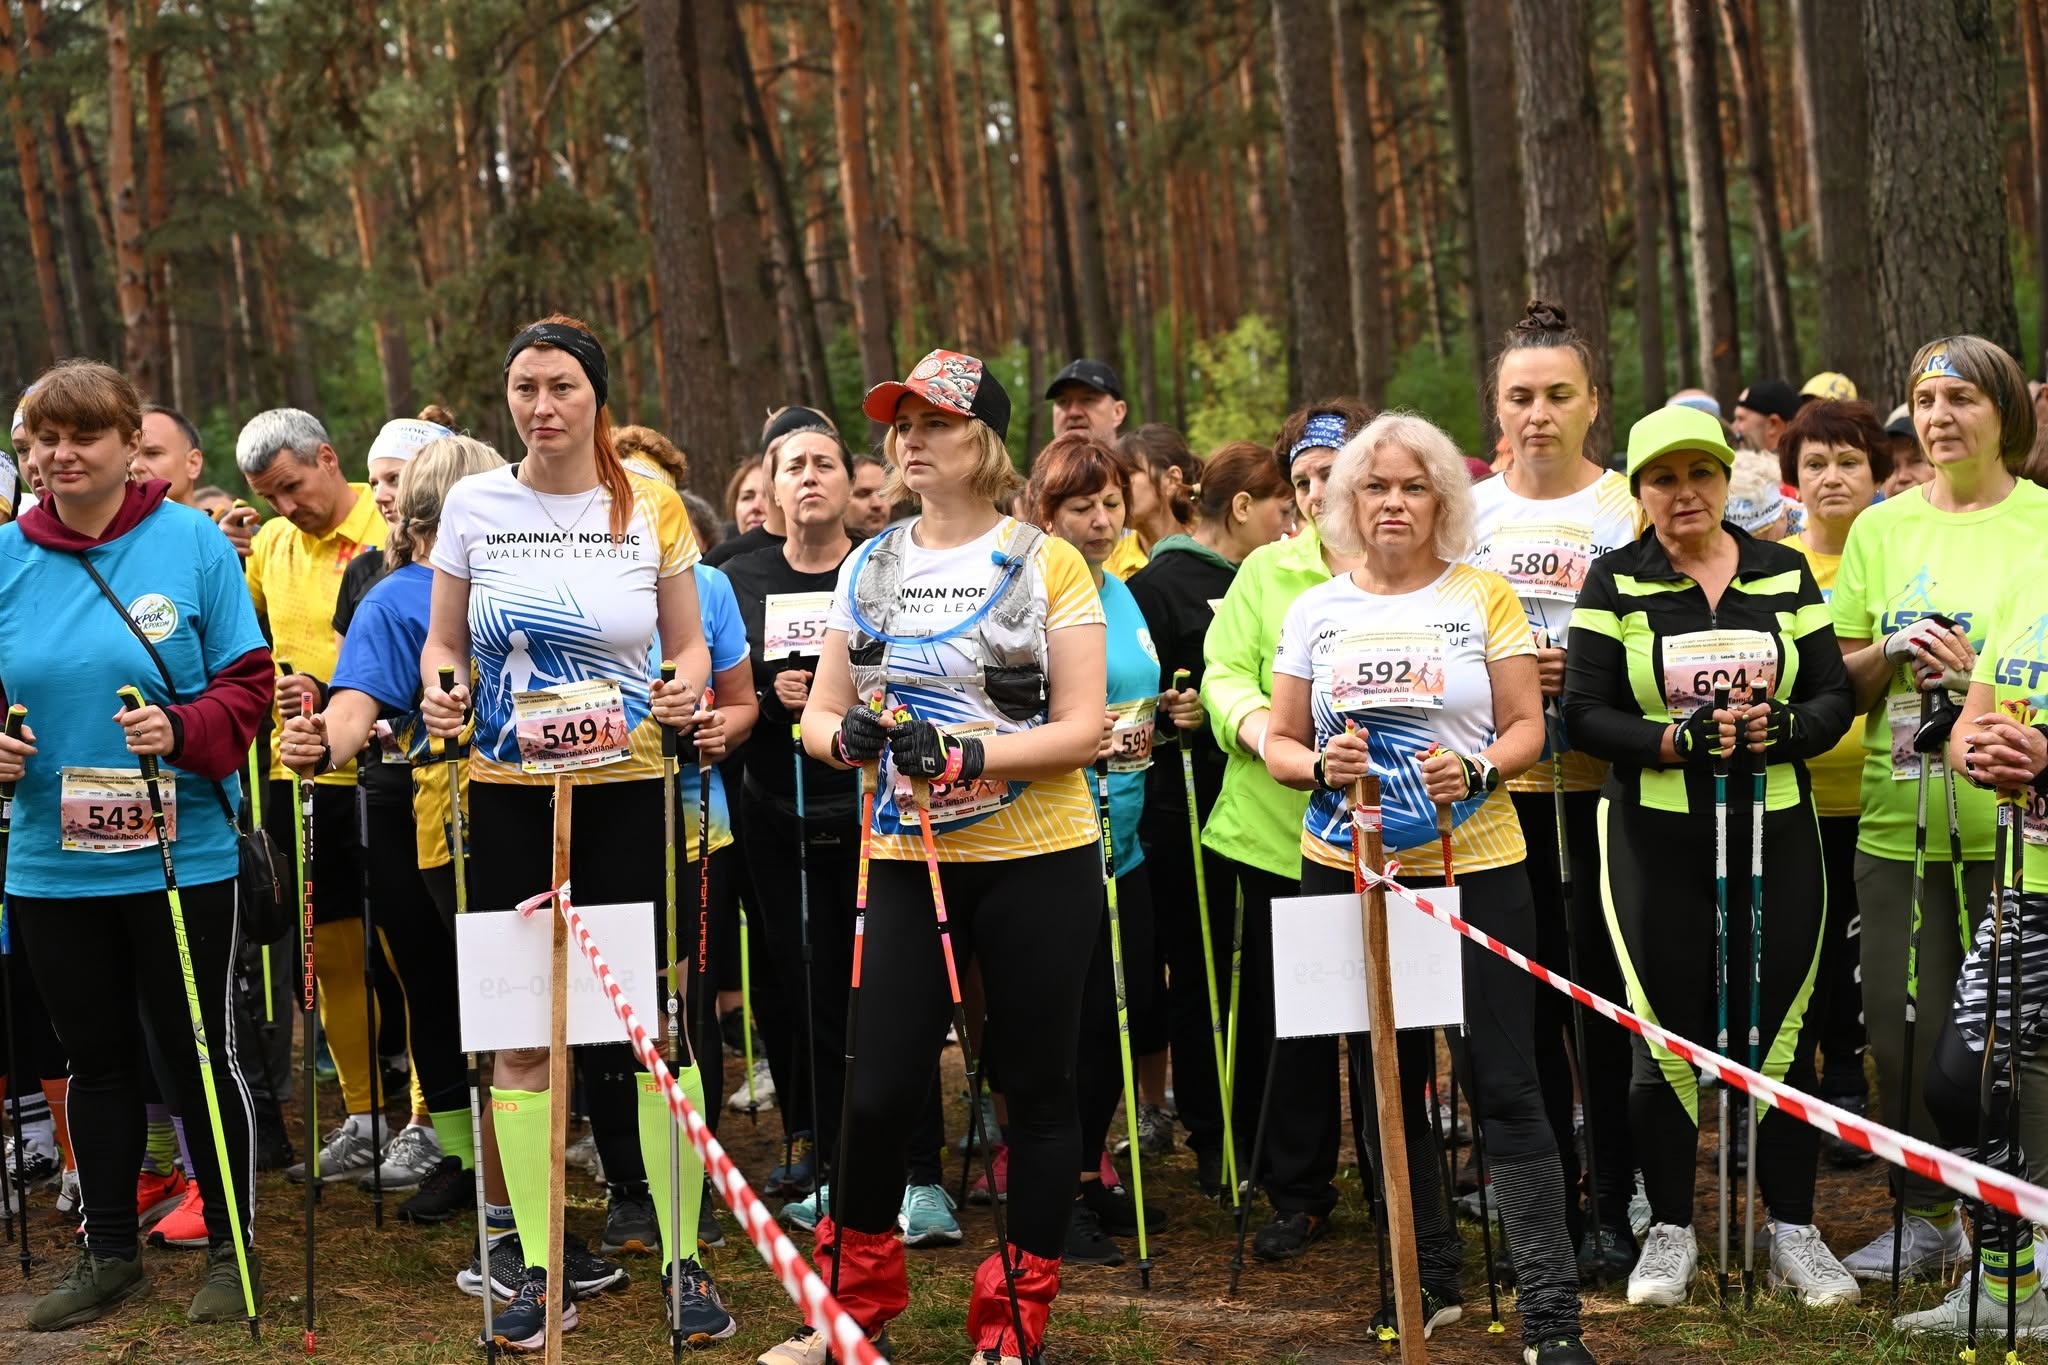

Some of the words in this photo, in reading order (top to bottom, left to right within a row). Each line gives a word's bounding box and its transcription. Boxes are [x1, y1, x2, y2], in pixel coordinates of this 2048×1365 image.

[486, 548, 564, 560] WALKING
[574, 548, 640, 561] LEAGUE
[1508, 553, 1559, 575] 580
[901, 588, 947, 598] INIAN
[944, 603, 977, 613] LEA
[787, 620, 827, 639] 557
[1357, 661, 1412, 686] 592
[1363, 687, 1392, 696] Bielova
[543, 718, 598, 750] 549
[1122, 728, 1147, 755] 593
[584, 743, 614, 755] Svitlana
[88, 805, 144, 831] 543
[159, 826, 174, 877] GABEL
[1102, 817, 1113, 863] GABEL
[304, 881, 314, 938] FLASH
[304, 942, 315, 1010] CARBON
[491, 1100, 518, 1112] PRO
